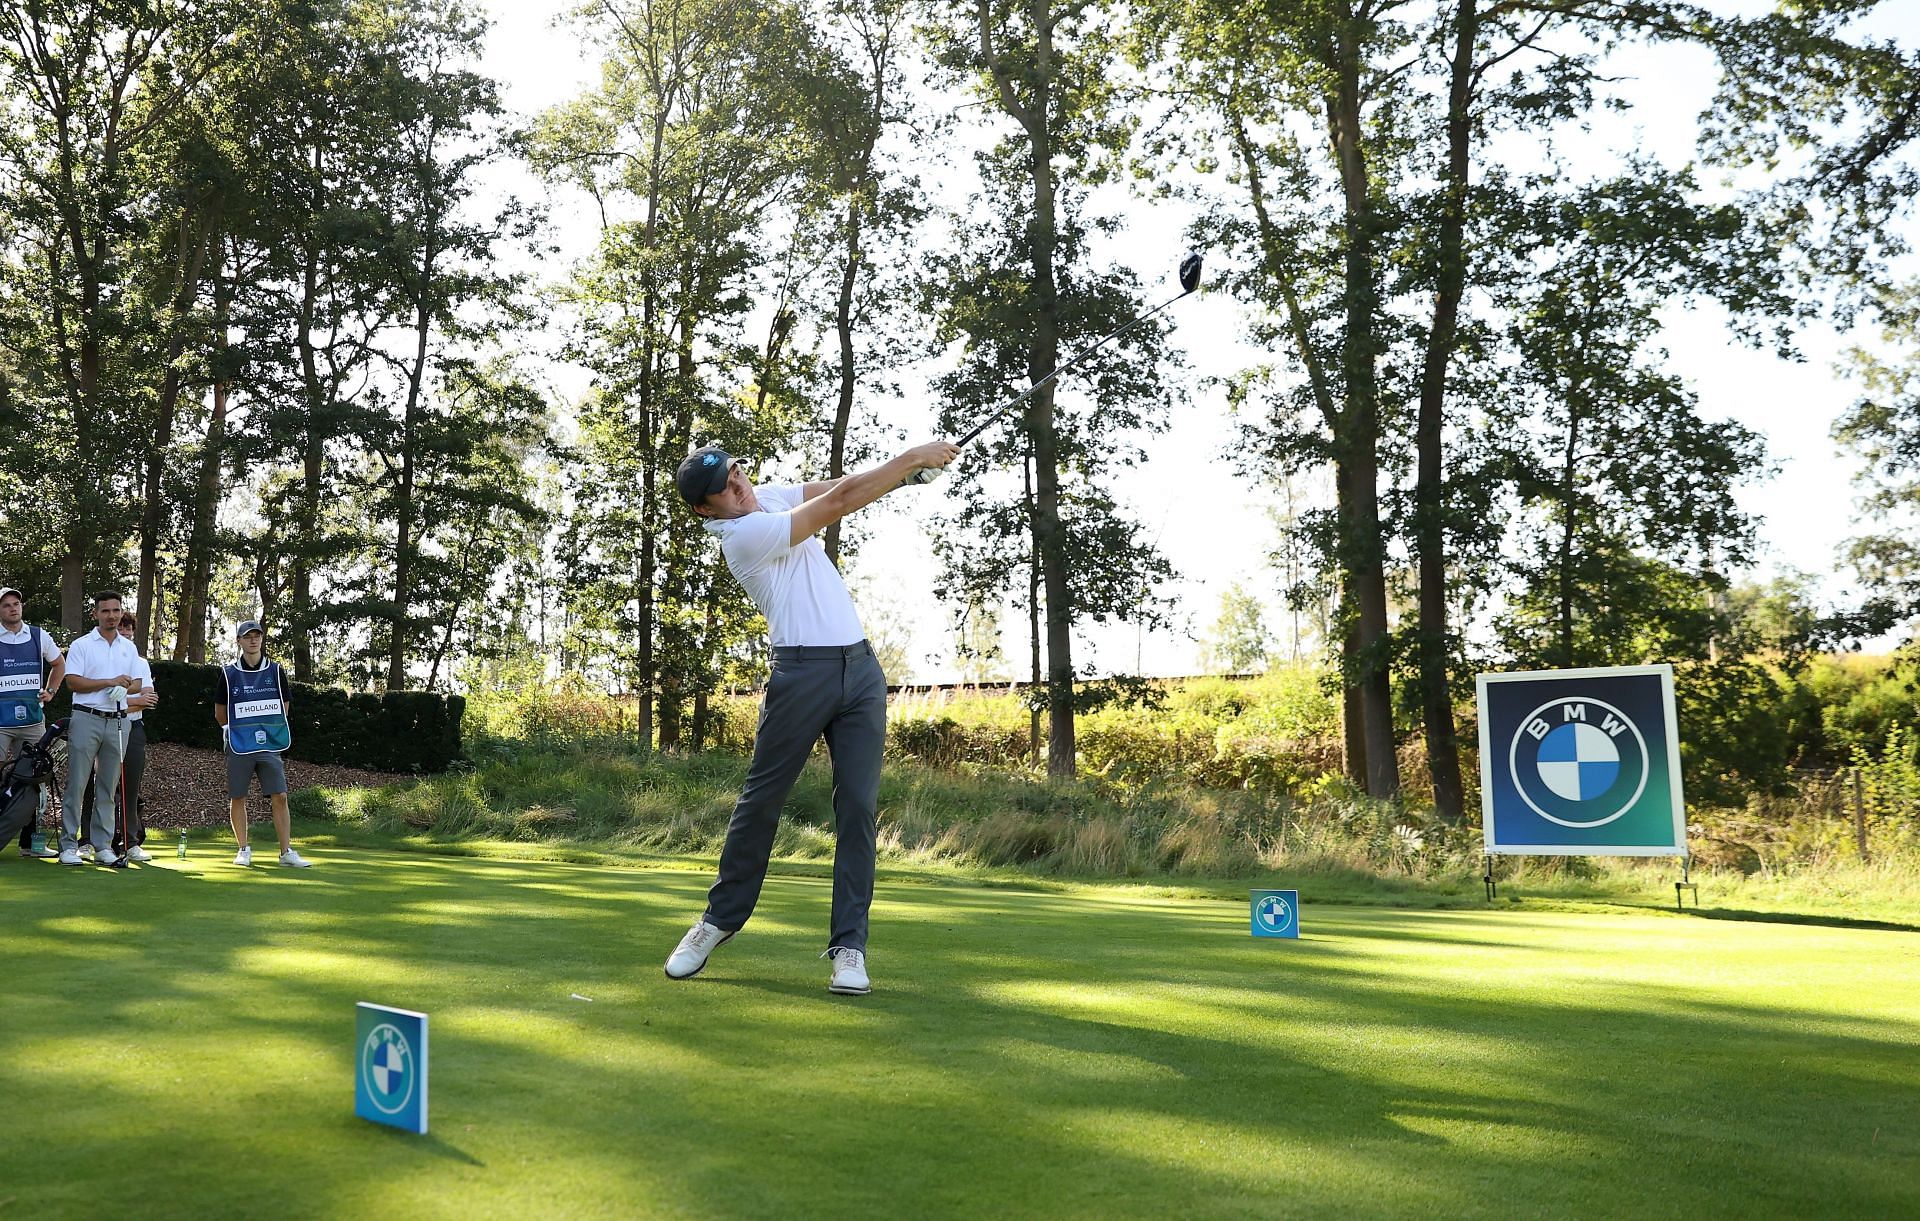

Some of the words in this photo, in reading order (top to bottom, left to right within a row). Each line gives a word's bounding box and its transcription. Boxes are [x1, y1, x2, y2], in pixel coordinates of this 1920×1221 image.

[5, 678, 39, 687] HOLLAND
[244, 703, 279, 713] HOLLAND
[1526, 704, 1628, 741] BMW
[1260, 897, 1287, 909] BMW
[369, 1028, 407, 1056] BMW
